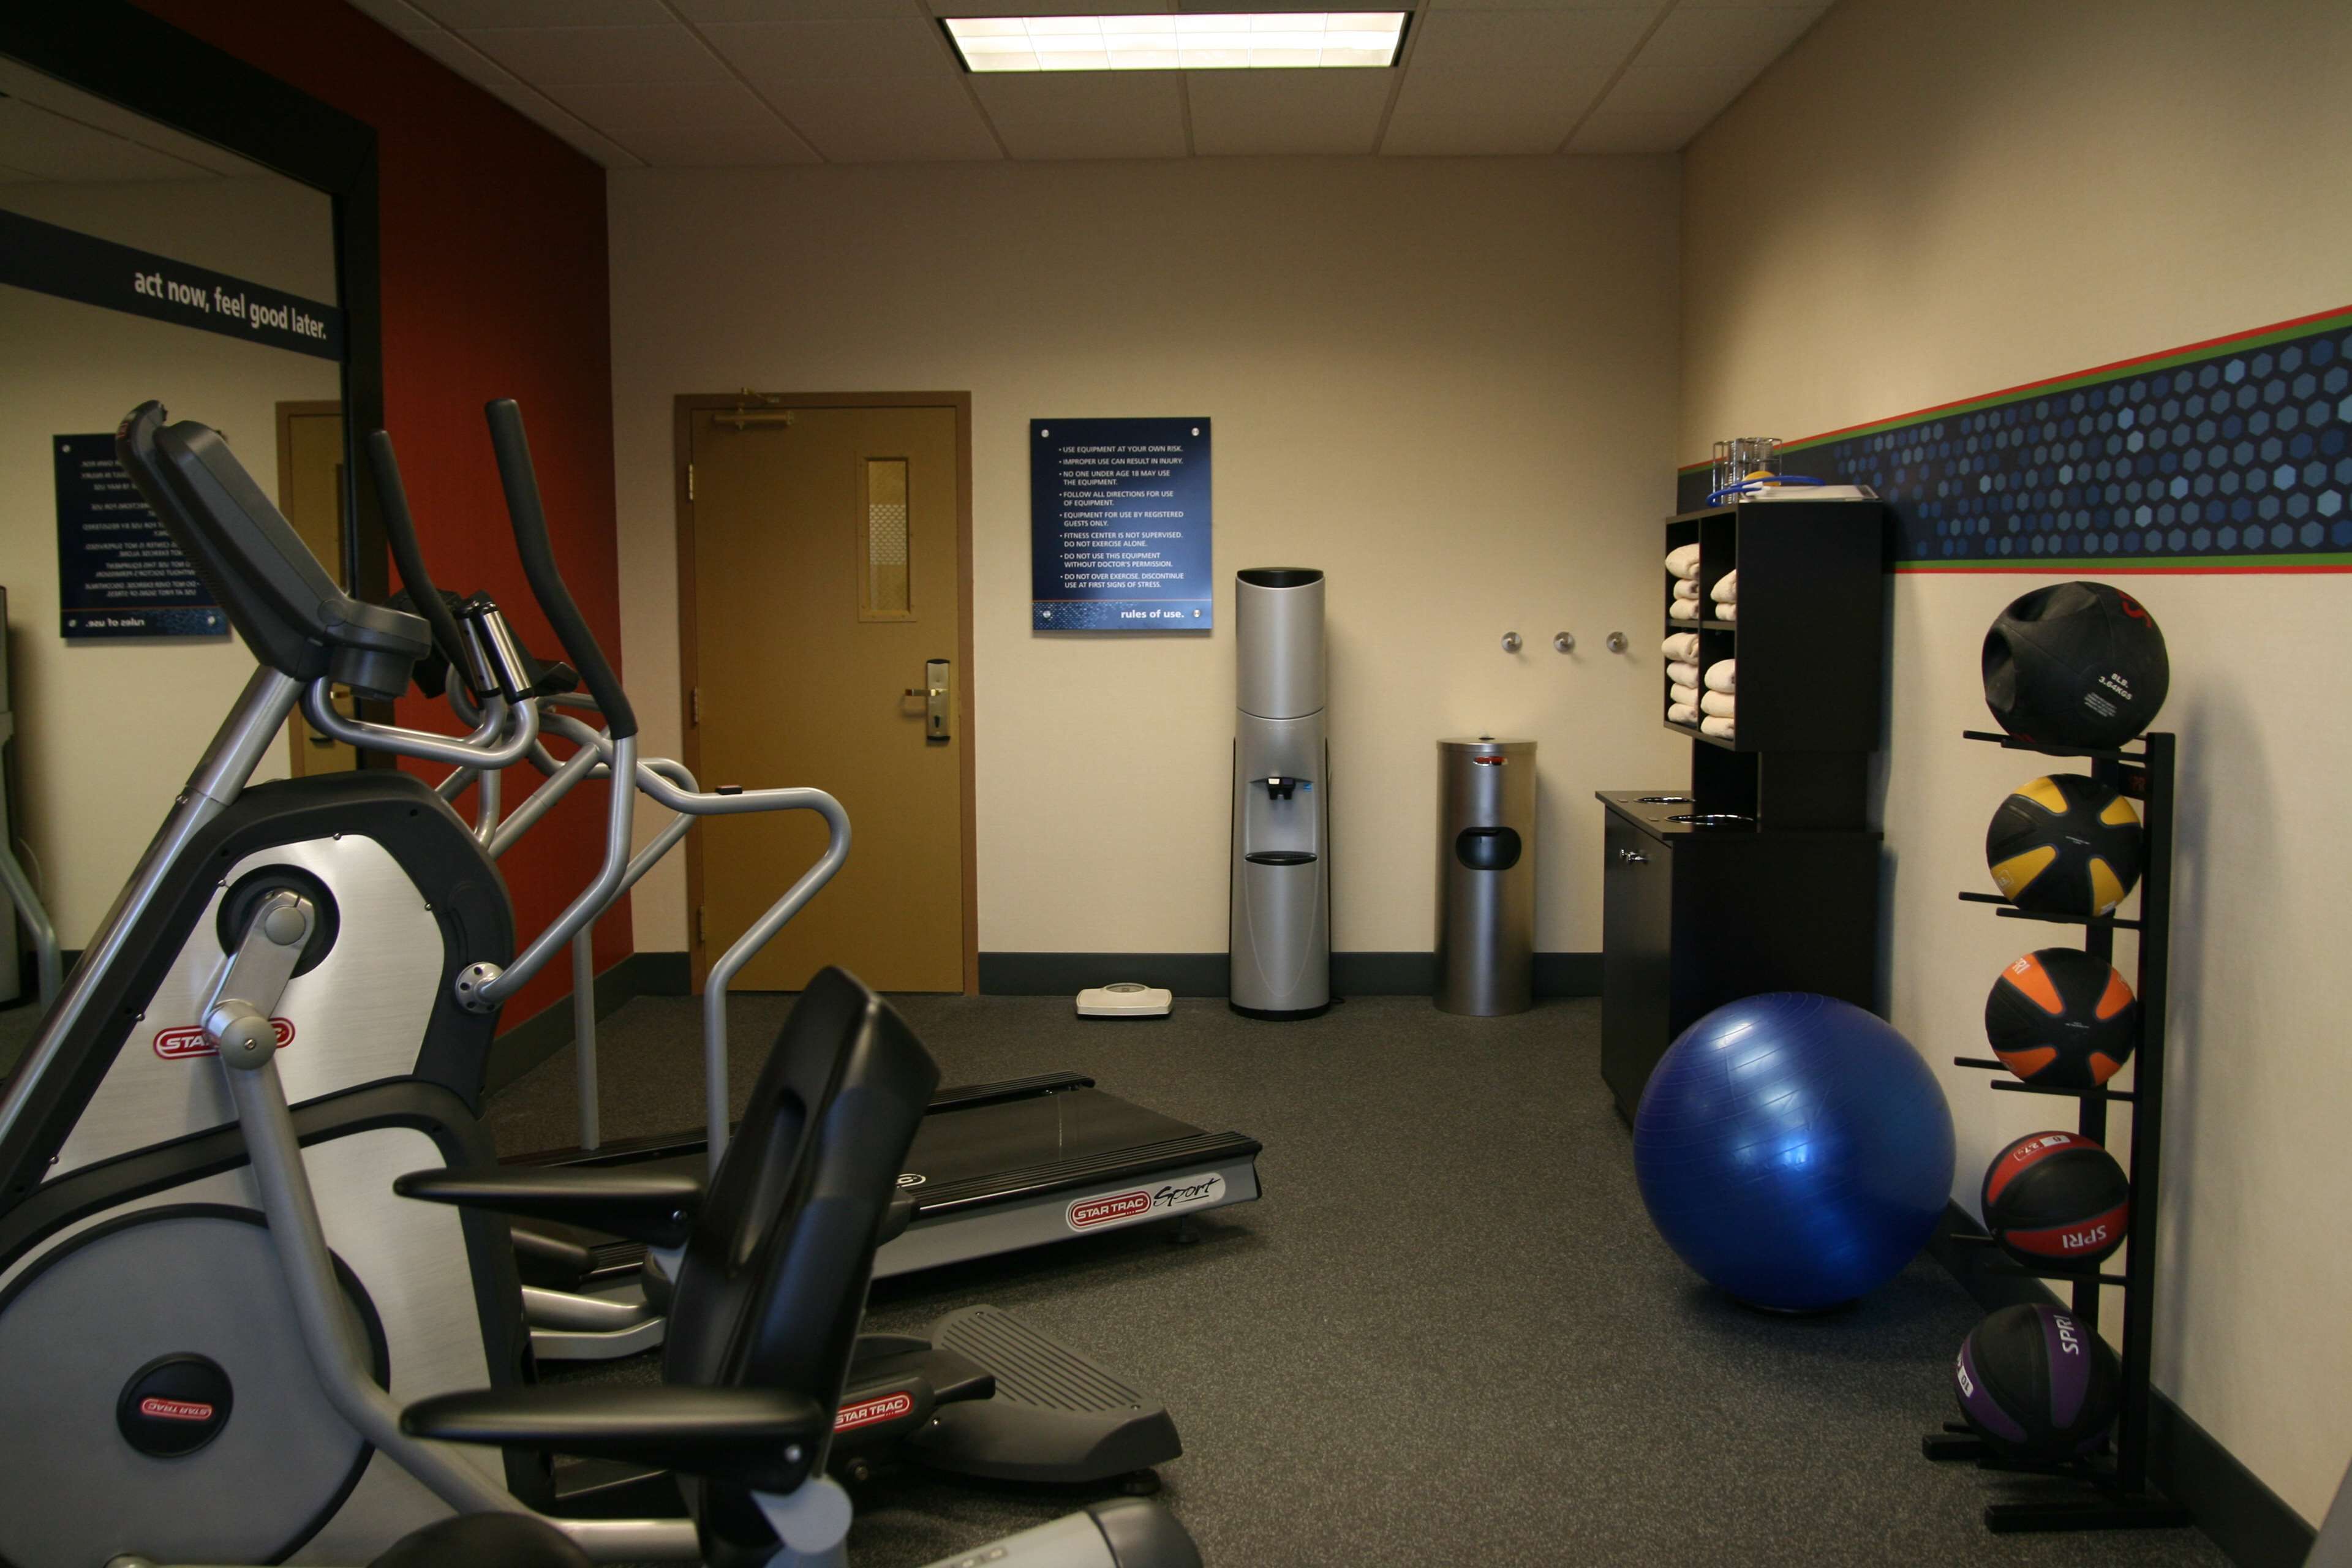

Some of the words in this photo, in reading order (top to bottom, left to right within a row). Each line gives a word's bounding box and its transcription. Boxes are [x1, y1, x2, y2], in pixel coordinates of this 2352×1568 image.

[134, 272, 164, 299] act
[168, 281, 209, 314] now,
[214, 286, 246, 319] feel
[250, 304, 288, 330] good
[292, 307, 326, 340] later.
[1121, 609, 1147, 619] rules
[1149, 609, 1161, 619] of
[1163, 609, 1184, 619] use.
[166, 1035, 209, 1049] STA
[1077, 1205, 1109, 1220] STAR
[1111, 1197, 1145, 1212] TRAC
[1153, 1178, 1221, 1207] Sport
[2062, 1225, 2106, 1248] SPRI
[2053, 1314, 2079, 1355] SPRI
[147, 1402, 178, 1412] TRAC
[179, 1406, 209, 1415] STAR
[835, 1408, 868, 1425] STAR
[869, 1399, 903, 1415] TRAC
